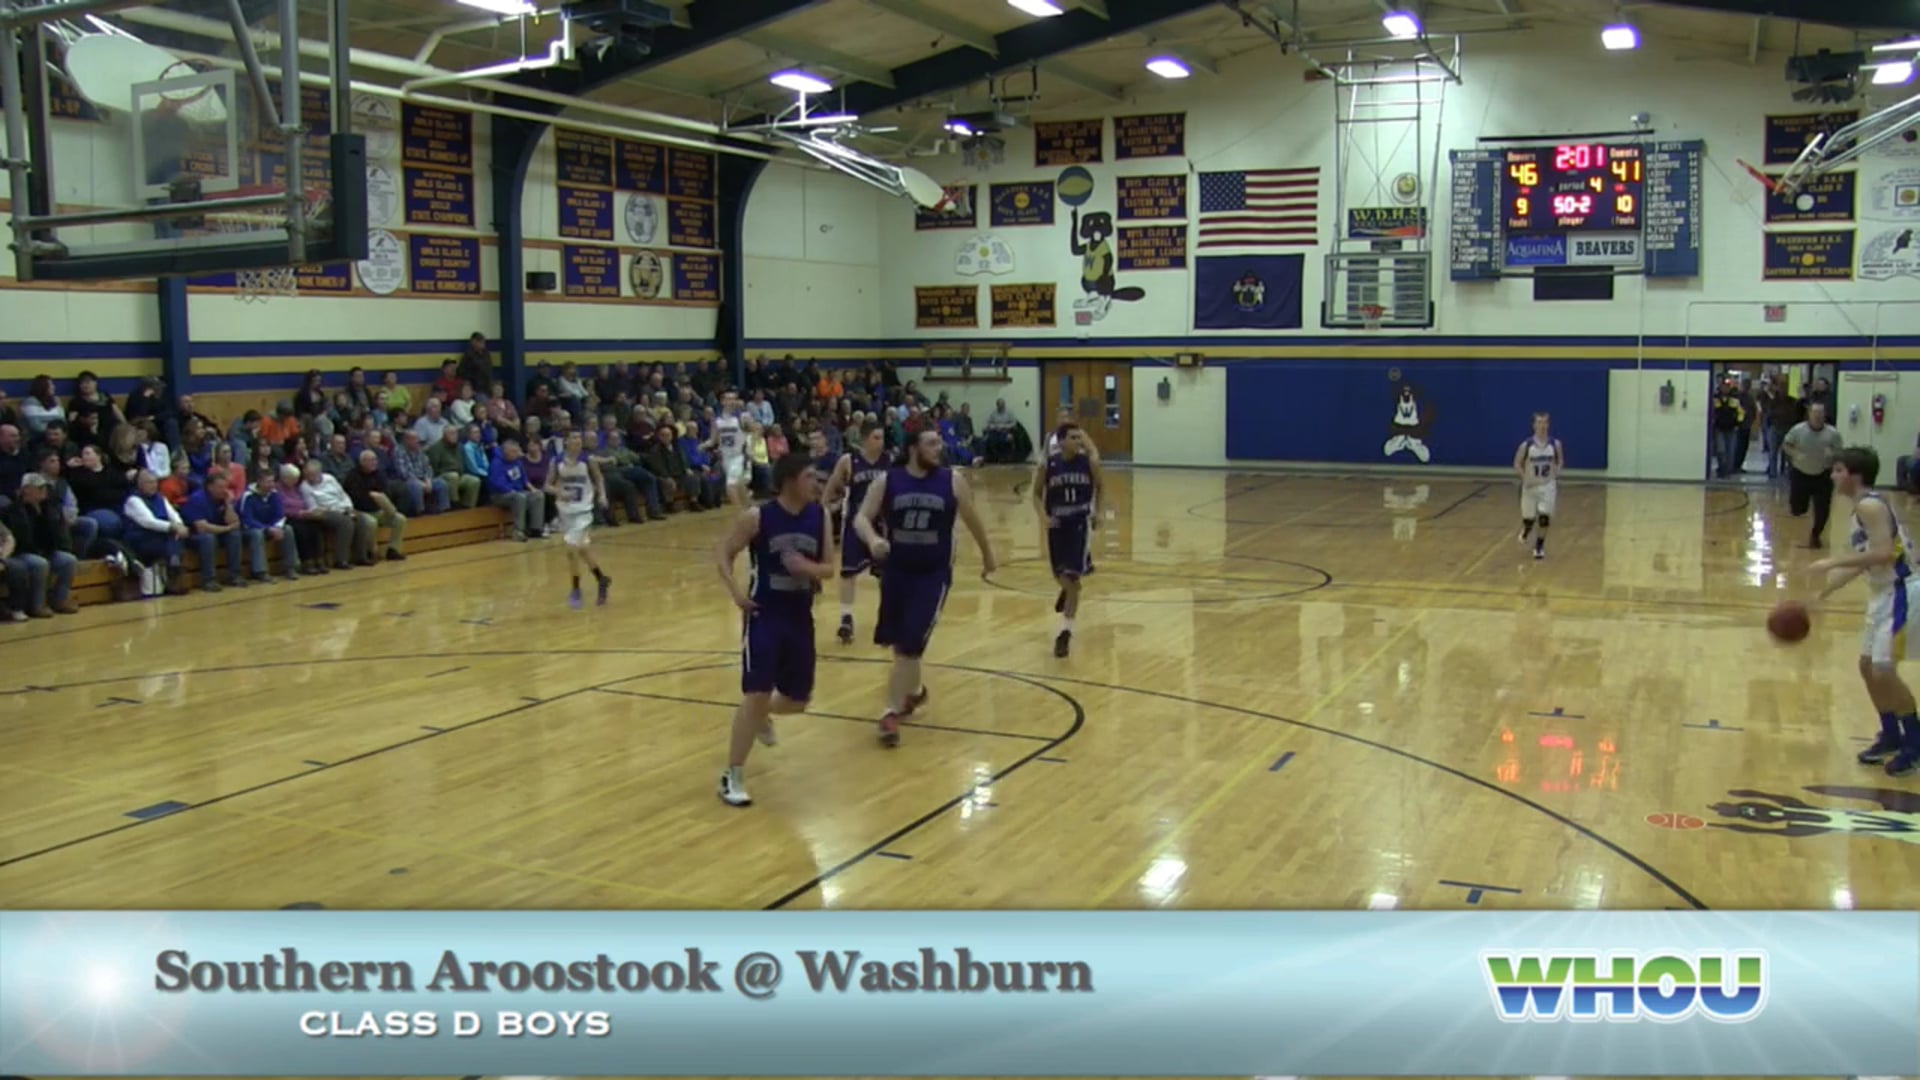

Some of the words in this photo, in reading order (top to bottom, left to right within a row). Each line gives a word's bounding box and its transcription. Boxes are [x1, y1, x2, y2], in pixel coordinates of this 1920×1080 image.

[1555, 145, 1605, 169] 2:01
[1510, 163, 1538, 185] 46
[1611, 160, 1640, 181] 41
[1558, 182, 1585, 192] period
[1589, 177, 1602, 193] 4
[1516, 197, 1528, 215] 9
[1616, 195, 1633, 213] 10
[1558, 216, 1585, 227] player
[1576, 241, 1635, 256] BEAVERS
[1399, 405, 1414, 418] W
[1534, 464, 1551, 478] 12
[1064, 487, 1076, 503] 11
